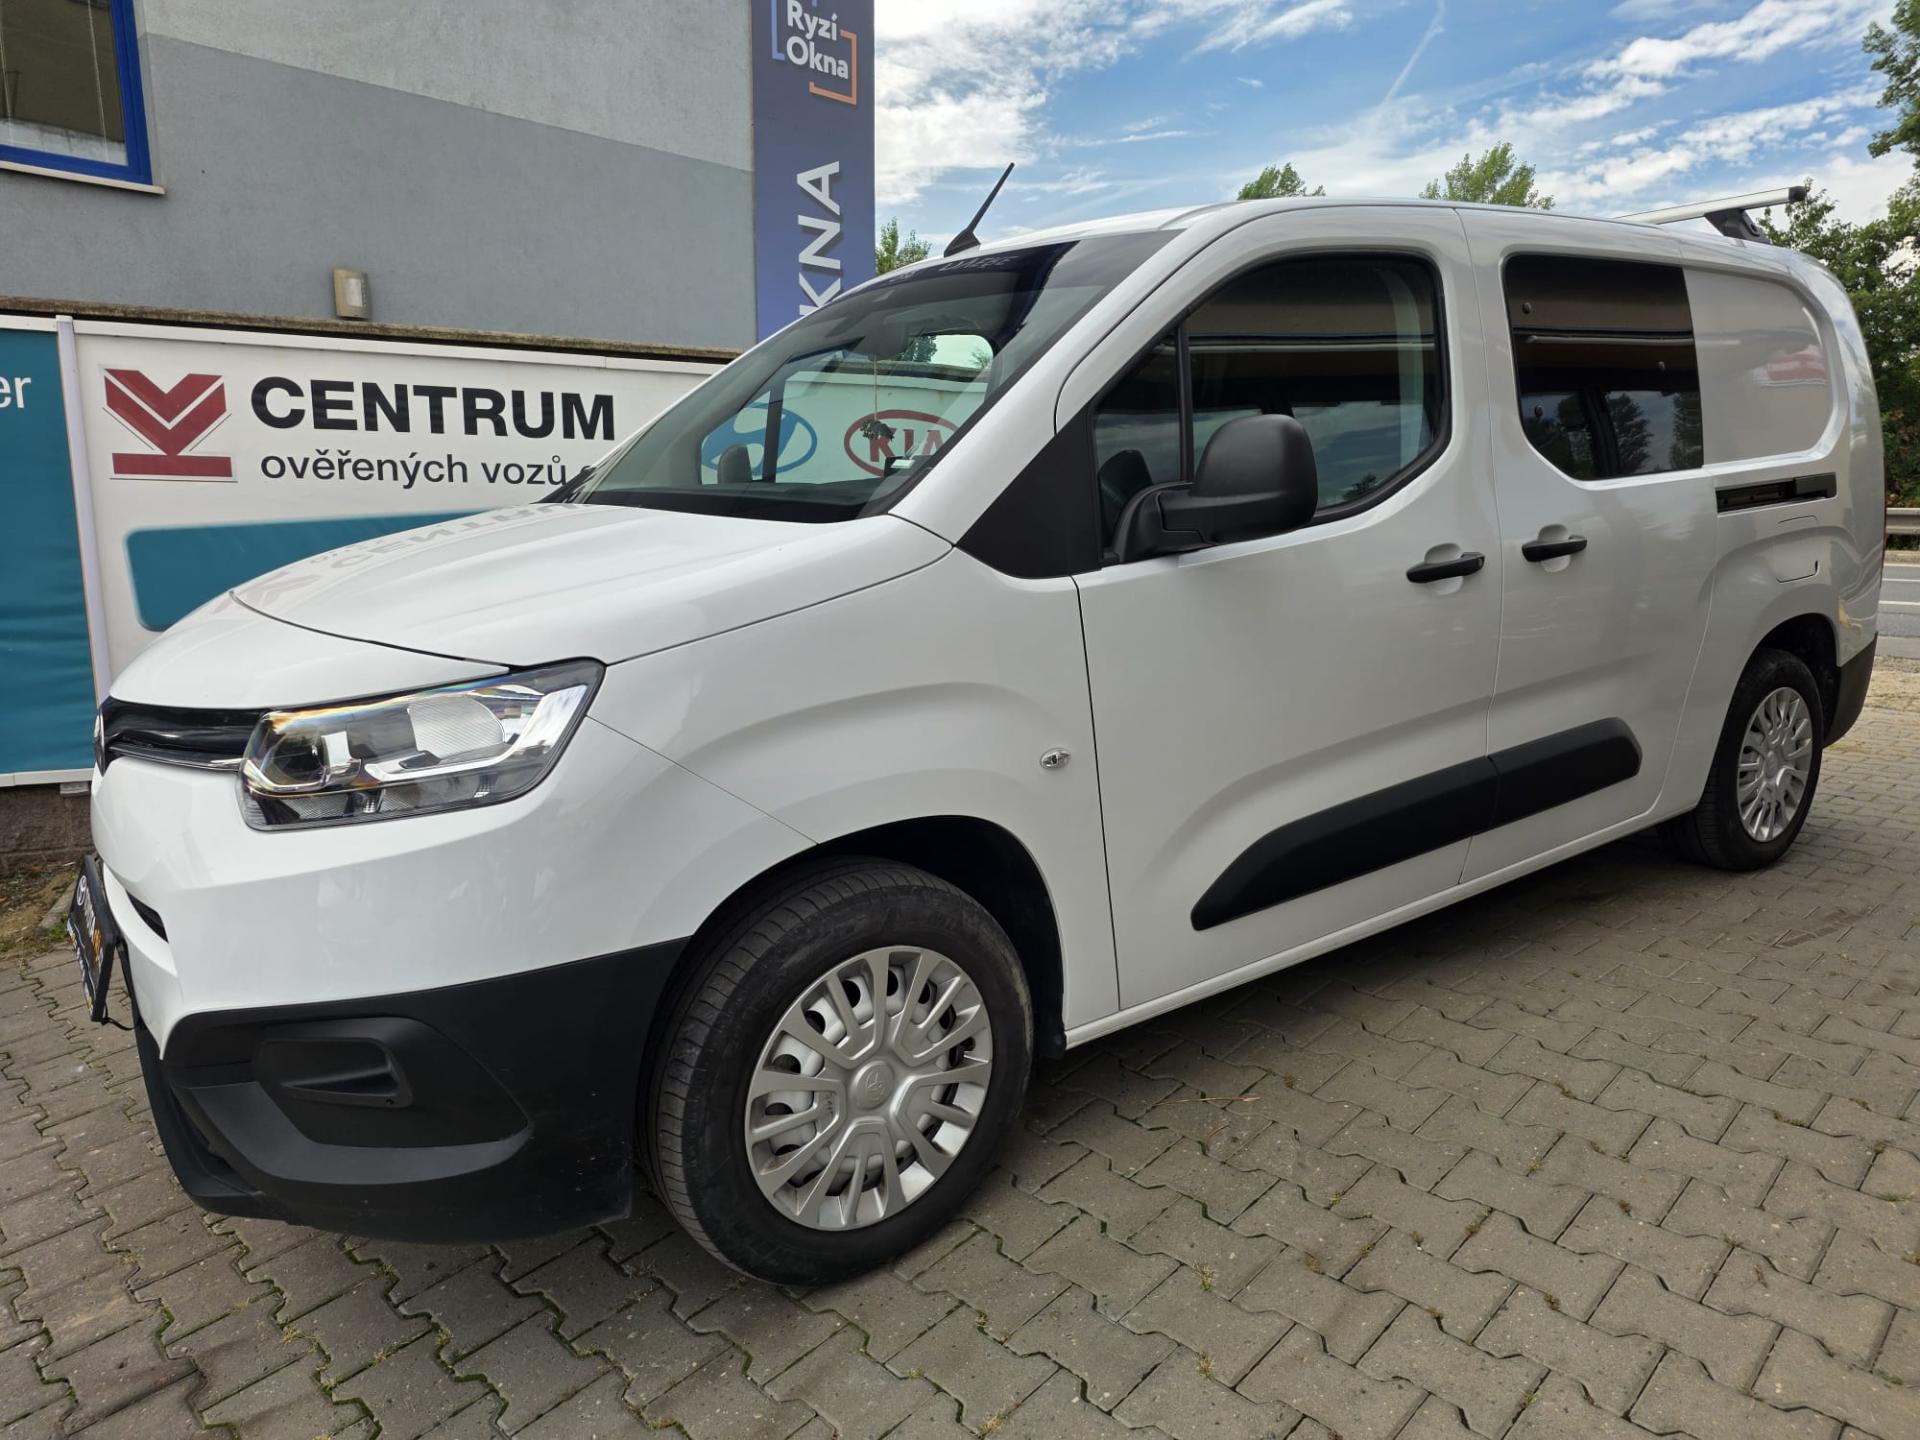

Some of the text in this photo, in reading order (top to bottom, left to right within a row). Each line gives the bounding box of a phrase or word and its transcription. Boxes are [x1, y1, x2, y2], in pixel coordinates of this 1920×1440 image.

[786, 35, 849, 80] Okna
[251, 376, 615, 441] CENTRUM
[260, 448, 567, 489] ověřených vozů
